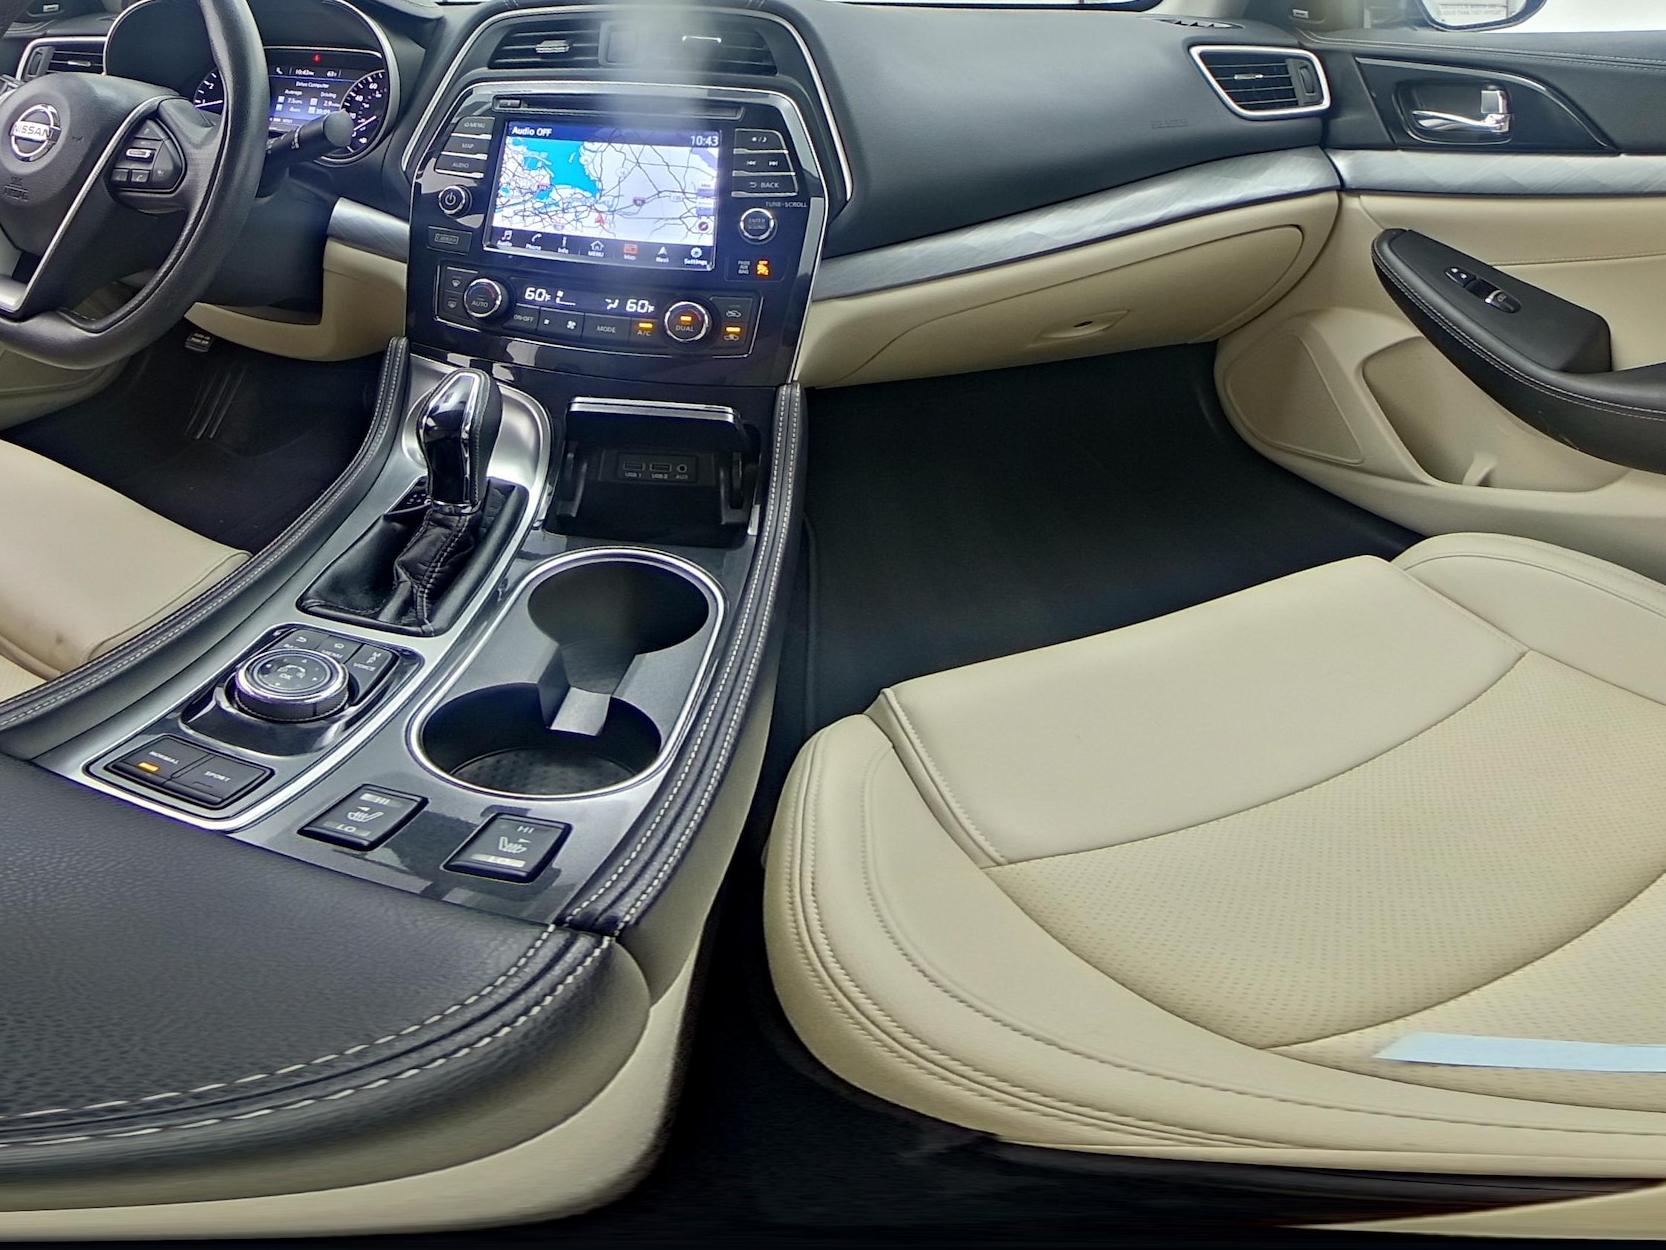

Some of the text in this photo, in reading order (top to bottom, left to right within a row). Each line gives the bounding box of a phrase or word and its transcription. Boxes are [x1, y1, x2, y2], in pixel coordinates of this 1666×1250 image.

[307, 81, 330, 89] Computer
[368, 82, 378, 90] 60
[320, 91, 337, 99] Driving
[13, 123, 53, 139] NISSAN
[511, 125, 553, 137] Audio OFF
[689, 135, 720, 147] 10:43
[452, 161, 470, 169] AUDIO
[760, 181, 780, 189] BACK
[525, 243, 542, 251] Phone
[557, 246, 569, 254] Info
[587, 250, 605, 258] MENU
[655, 256, 670, 264] Navi
[683, 257, 708, 268] Settings
[470, 300, 489, 309] AUTO
[596, 325, 617, 334] MODE
[675, 324, 695, 332] DUAL
[637, 329, 652, 337] A/C
[353, 662, 377, 672] VOICE
[279, 673, 293, 681] OK
[148, 750, 179, 765] NORMAL
[204, 770, 232, 783] SPORT
[375, 796, 391, 805] HI
[335, 823, 355, 833] LO
[516, 825, 535, 834] HI
